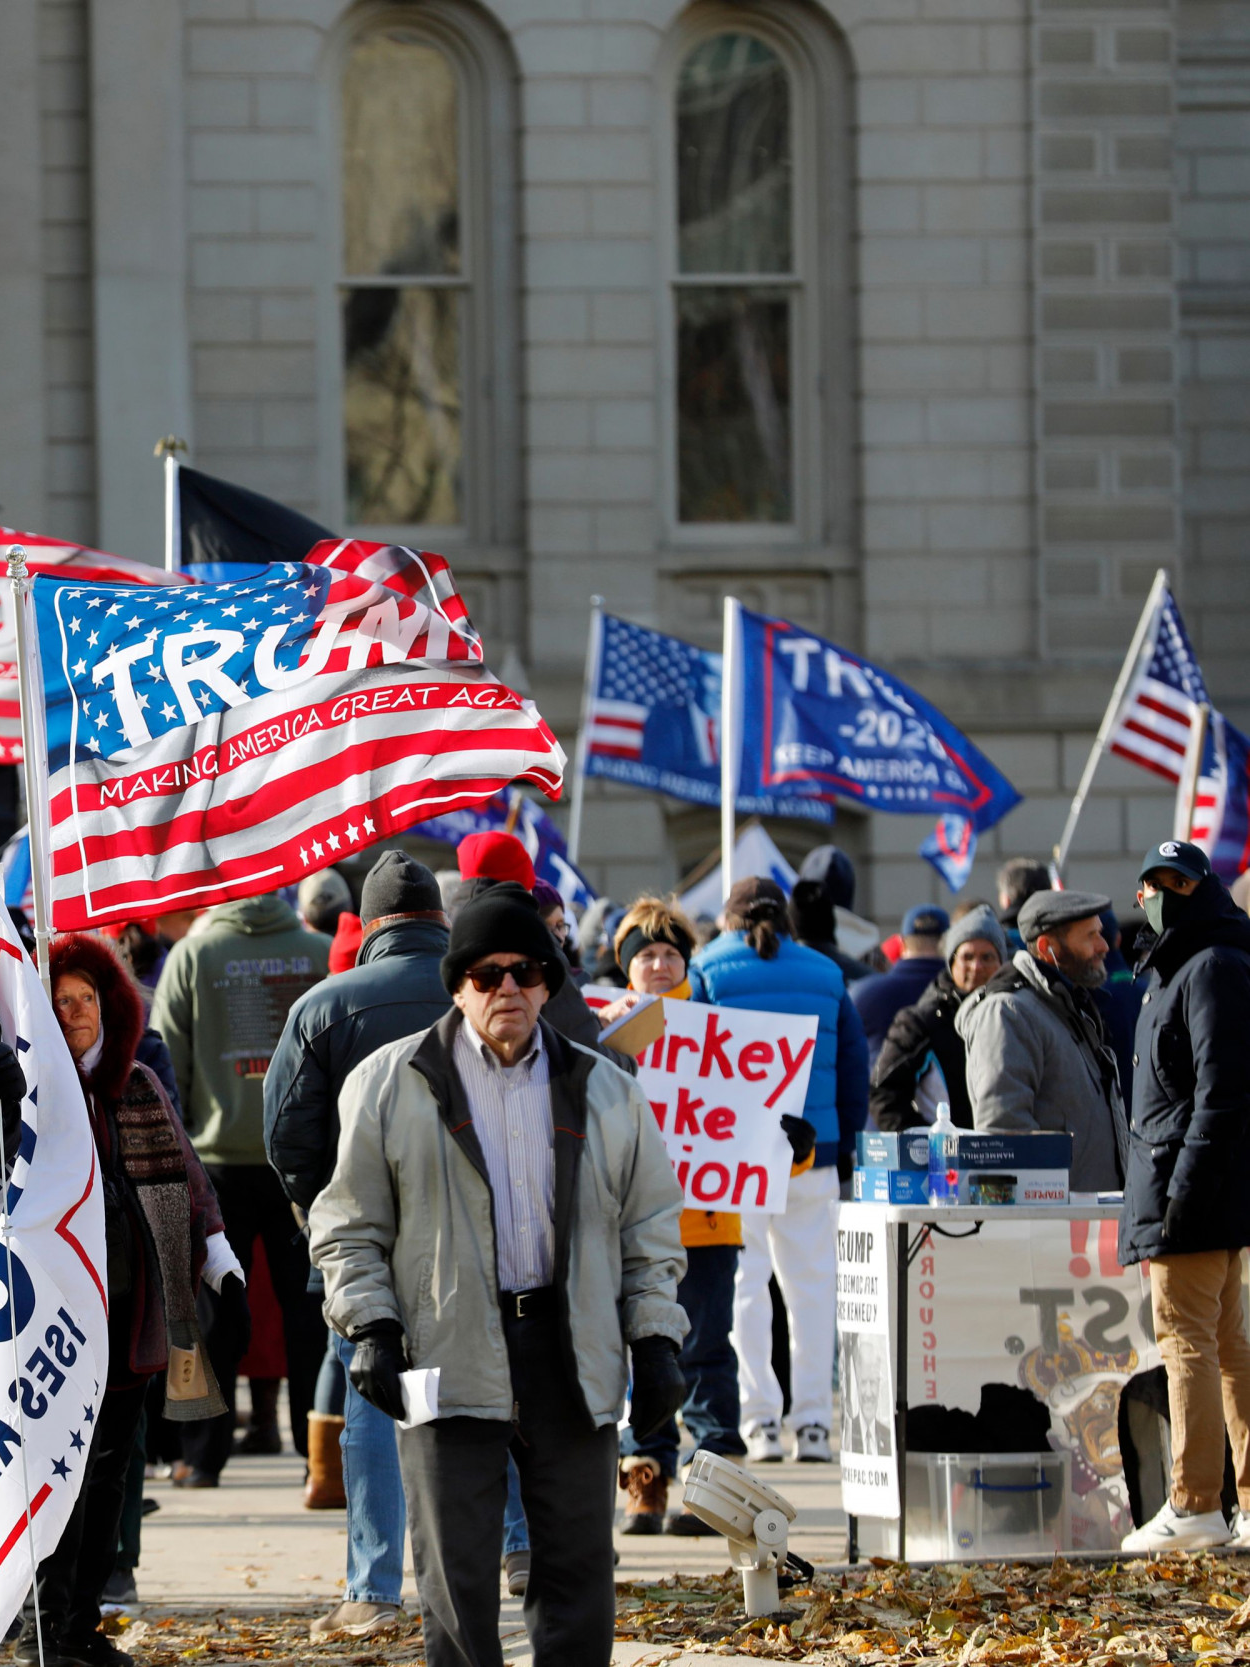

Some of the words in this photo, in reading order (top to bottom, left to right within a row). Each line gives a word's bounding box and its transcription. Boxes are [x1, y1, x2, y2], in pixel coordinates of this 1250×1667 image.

[92, 590, 480, 748] TRUM
[100, 750, 219, 805] MAKING
[228, 706, 324, 766] AMERICA
[331, 686, 439, 721] GREAT
[447, 686, 521, 707] AGA
[774, 743, 835, 767] KEEP
[838, 756, 939, 785] AMERICA
[1024, 1190, 1064, 1200] STAPLES
